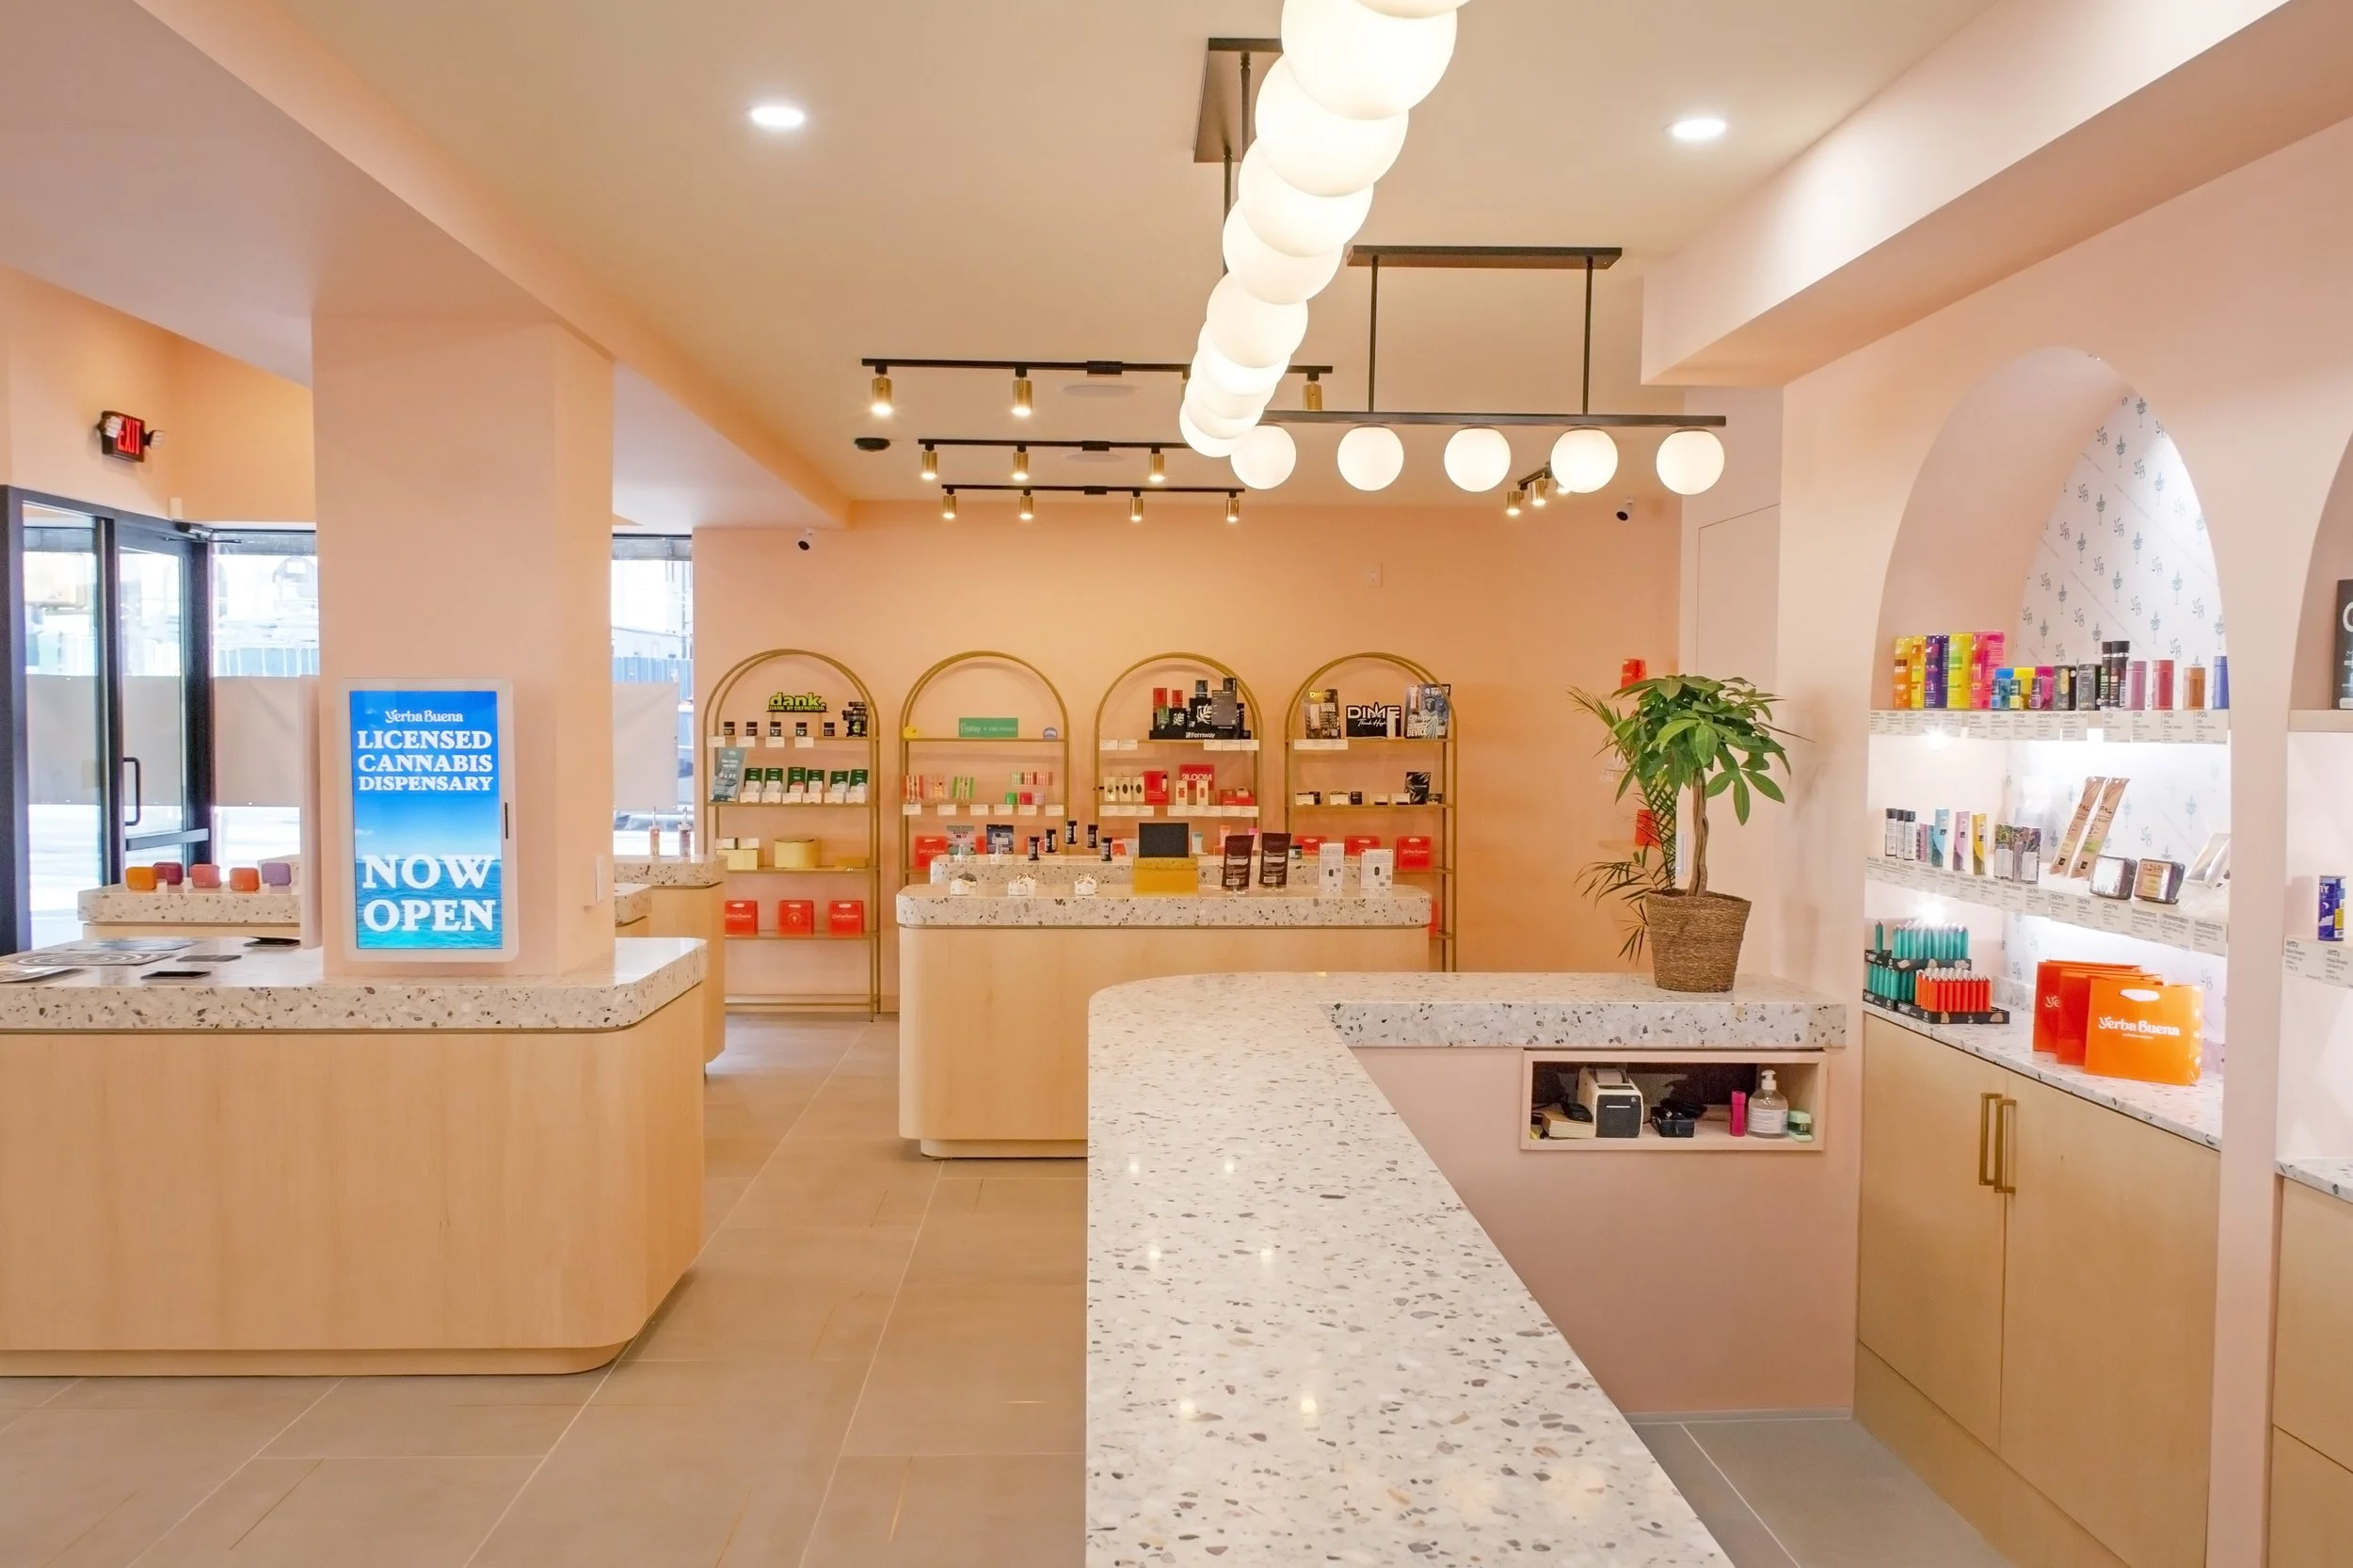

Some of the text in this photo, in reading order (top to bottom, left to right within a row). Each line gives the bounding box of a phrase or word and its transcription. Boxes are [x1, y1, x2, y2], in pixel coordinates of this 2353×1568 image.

[118, 415, 141, 455] EXIT
[384, 709, 464, 724] Yerba Buena
[1347, 703, 1401, 719] DIME
[357, 729, 492, 750] LICENSED
[358, 754, 493, 773] CANNABIS
[358, 776, 494, 792] DISPENSARY
[1181, 773, 1212, 781] BLOOM
[362, 854, 495, 889] NOW
[363, 899, 497, 933] OPEN
[2099, 1016, 2137, 1032] Yerba
[2137, 1020, 2180, 1036] Buena
